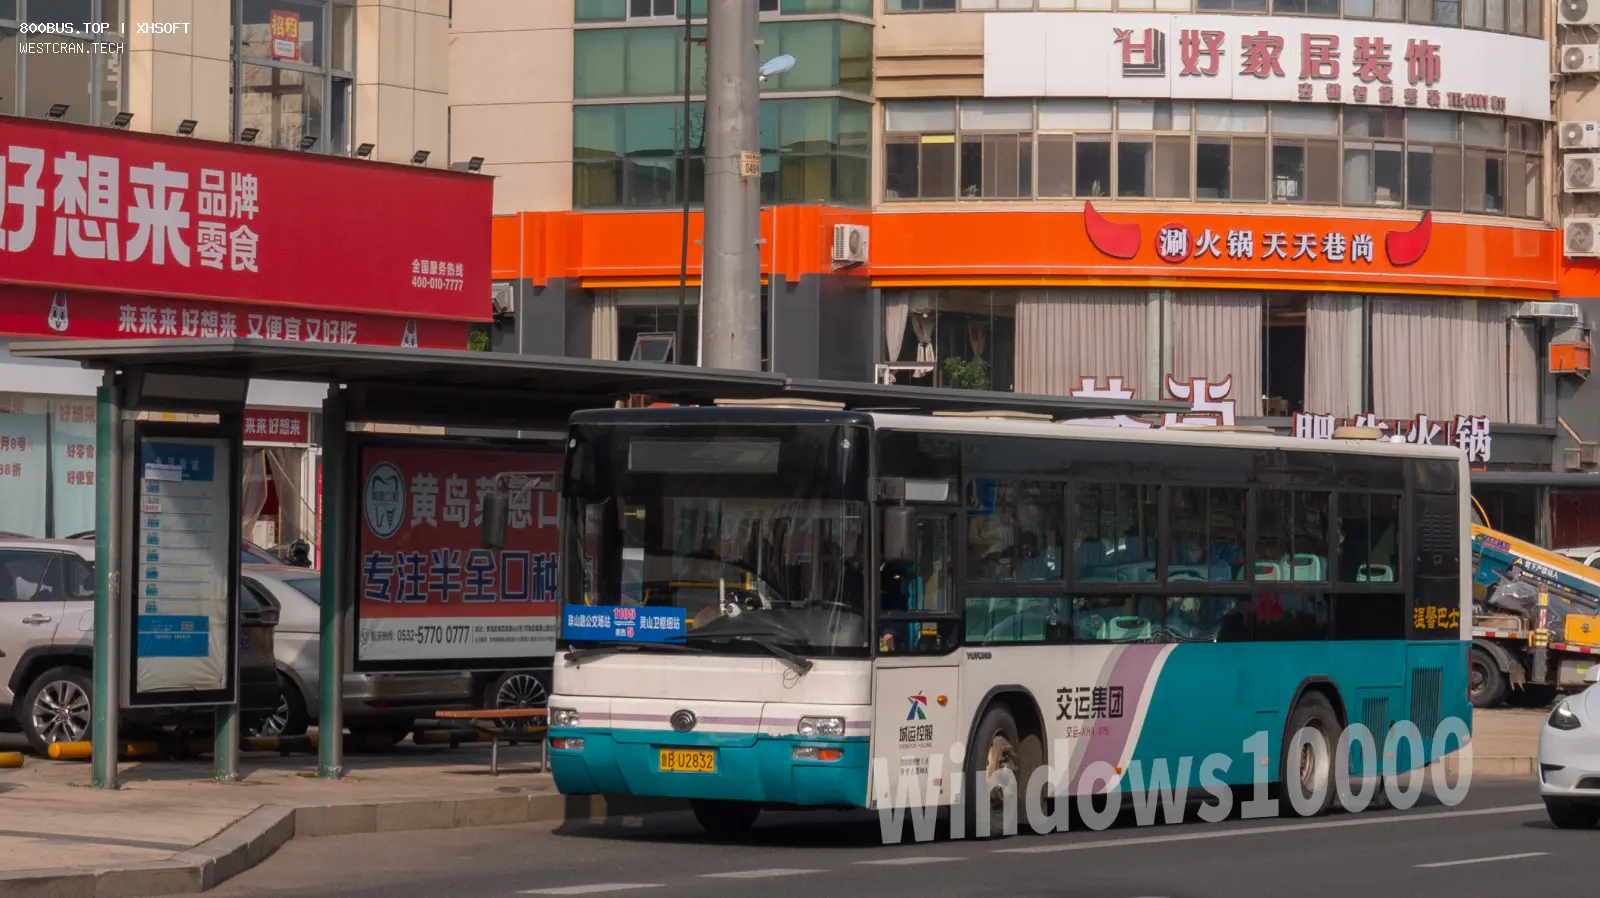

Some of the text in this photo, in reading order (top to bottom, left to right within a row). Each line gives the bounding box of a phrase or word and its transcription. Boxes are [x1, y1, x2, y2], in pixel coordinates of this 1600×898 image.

[272, 15, 297, 37] 招租
[1179, 29, 1442, 84] 好家居装饰
[198, 168, 259, 220] 品牌
[0, 145, 190, 267] 好想来
[197, 221, 259, 272] 零食
[1261, 231, 1374, 262] 天天巷尚
[411, 258, 464, 277] 全国服务热线
[412, 275, 464, 291] 400-010-7777
[118, 304, 177, 335] 来来来
[181, 308, 238, 338] 好想来
[67, 444, 95, 459] 好零食
[66, 470, 94, 485] 好便宜
[613, 607, 637, 620] 1105
[1413, 605, 1460, 629] 温馨巴士
[445, 625, 470, 644] 0777
[1055, 686, 1124, 721] 交运集团
[899, 724, 933, 742] 城运控股
